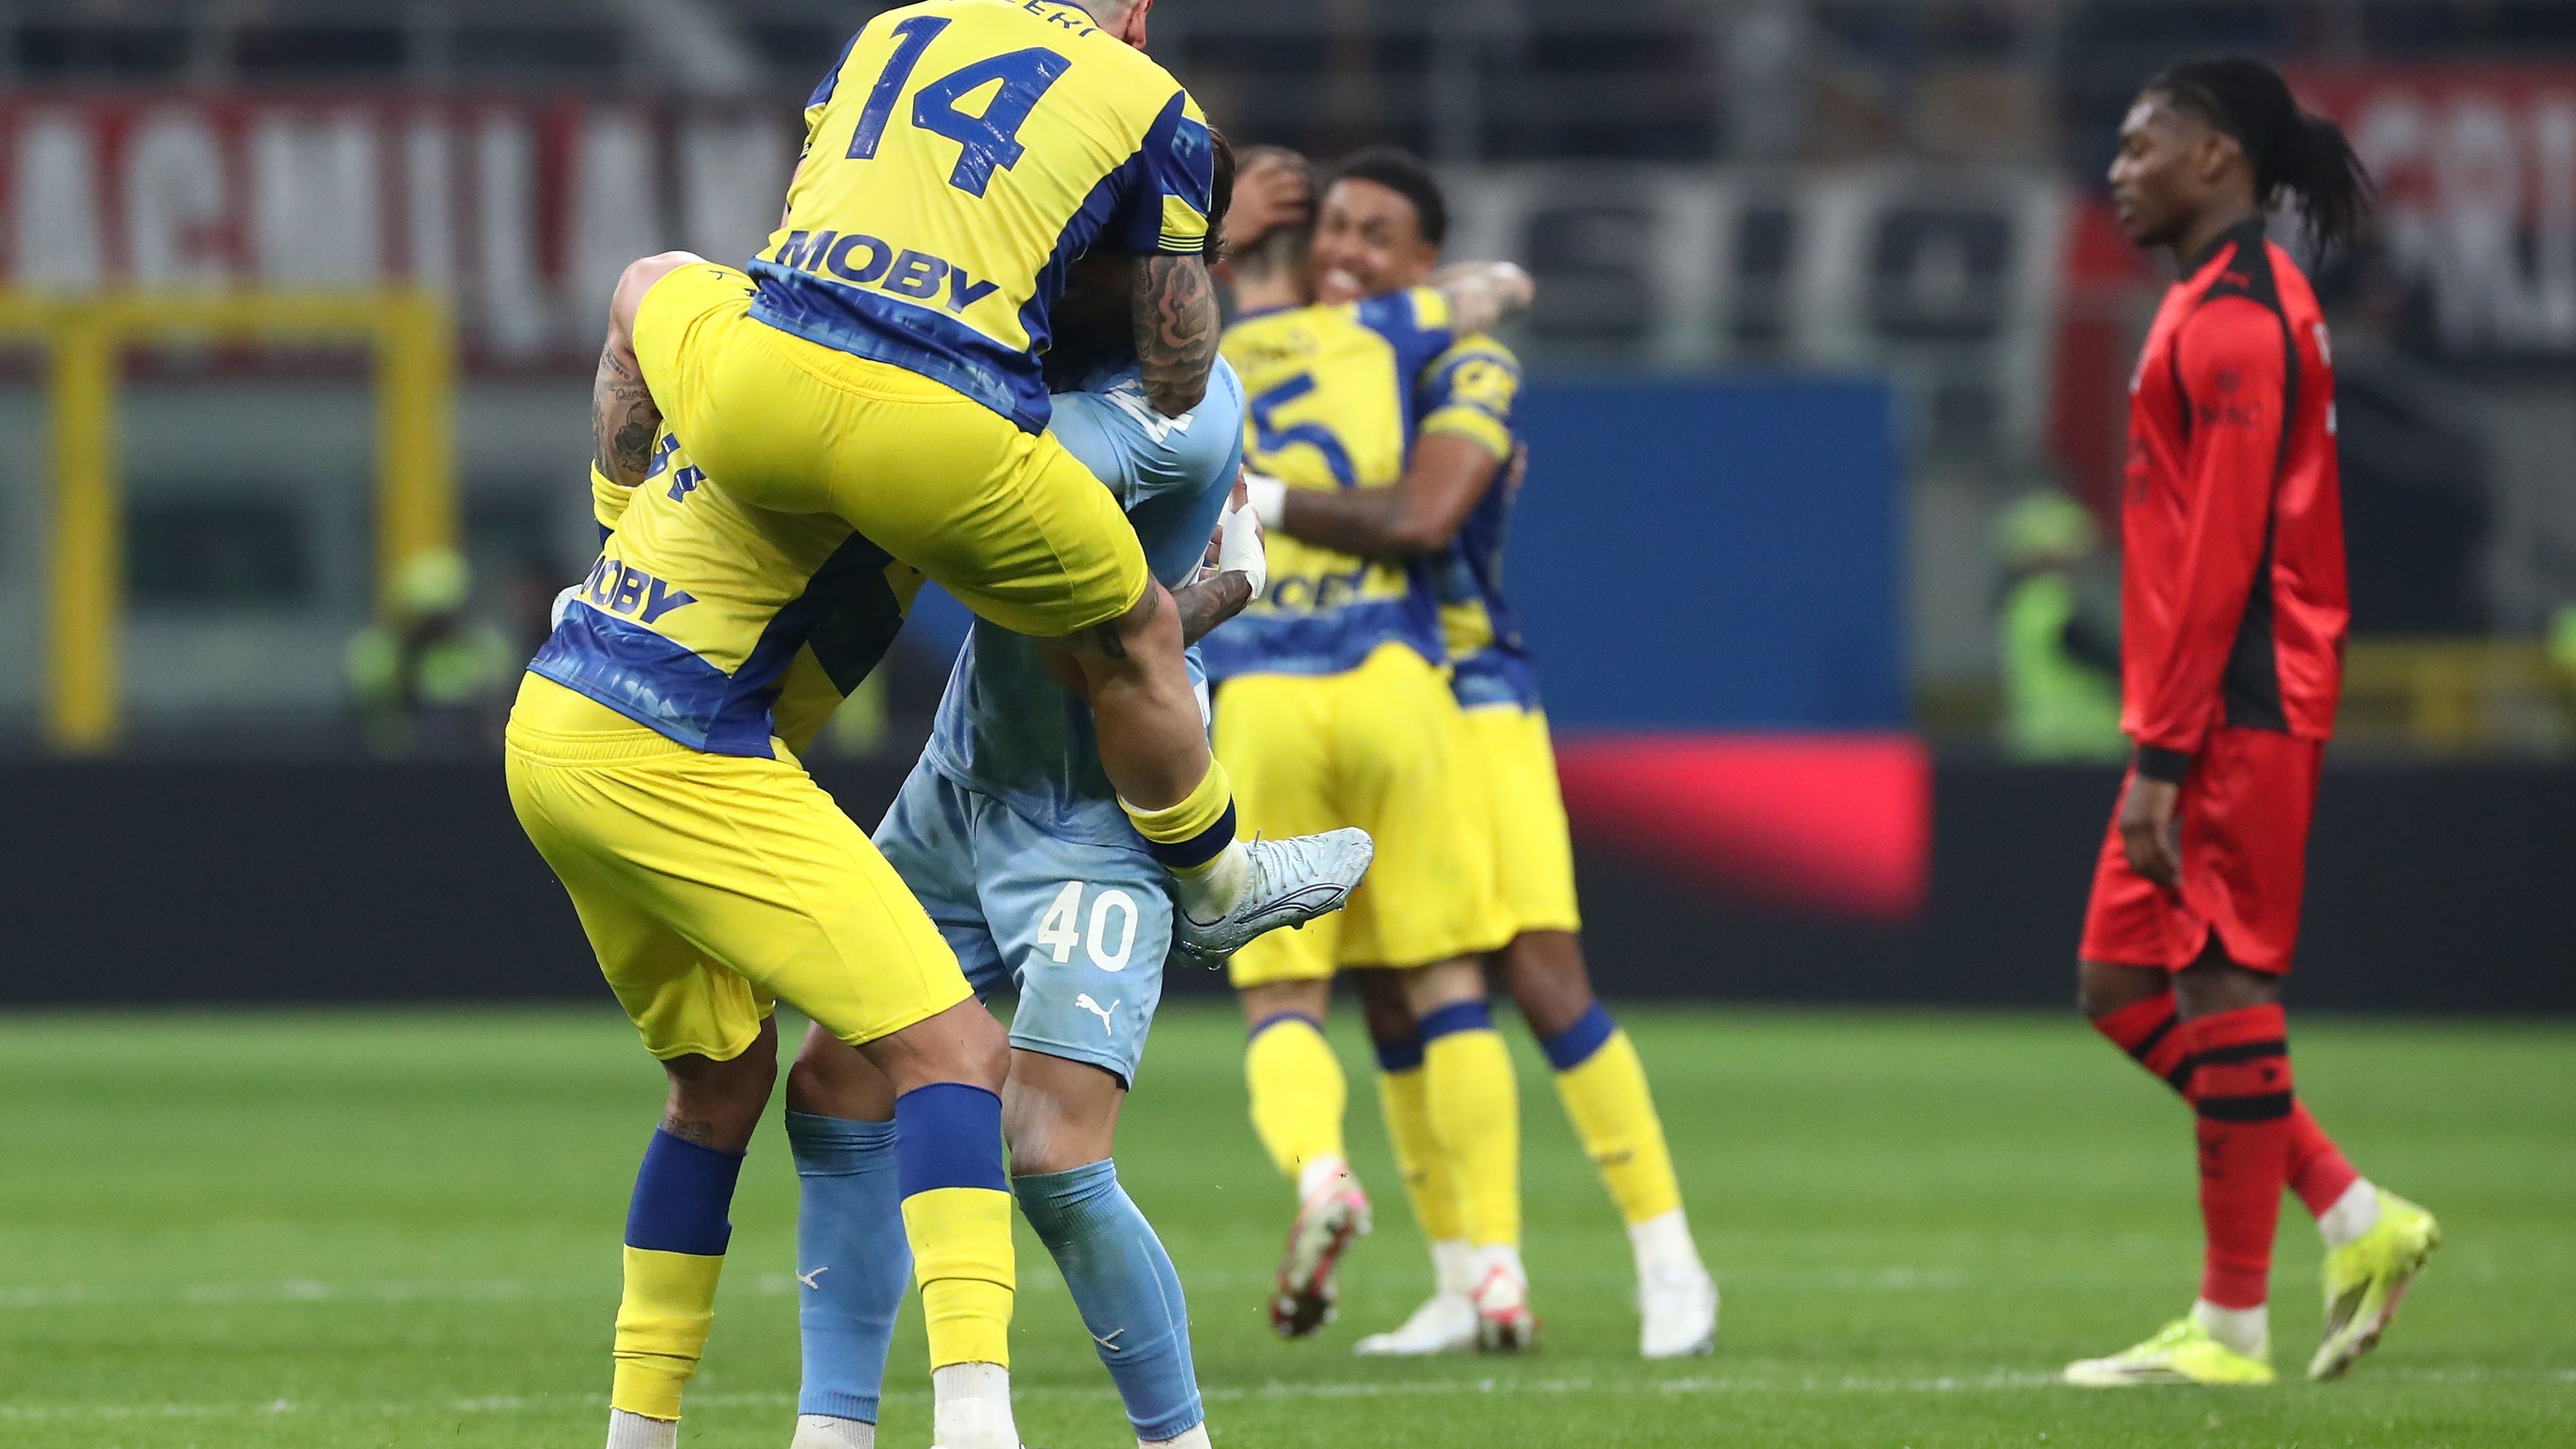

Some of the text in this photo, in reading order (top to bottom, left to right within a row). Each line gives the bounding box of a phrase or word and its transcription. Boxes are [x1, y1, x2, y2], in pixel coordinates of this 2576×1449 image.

[845, 15, 1071, 199] 14
[775, 230, 999, 314] MOBY
[1037, 880, 1138, 972] 40
